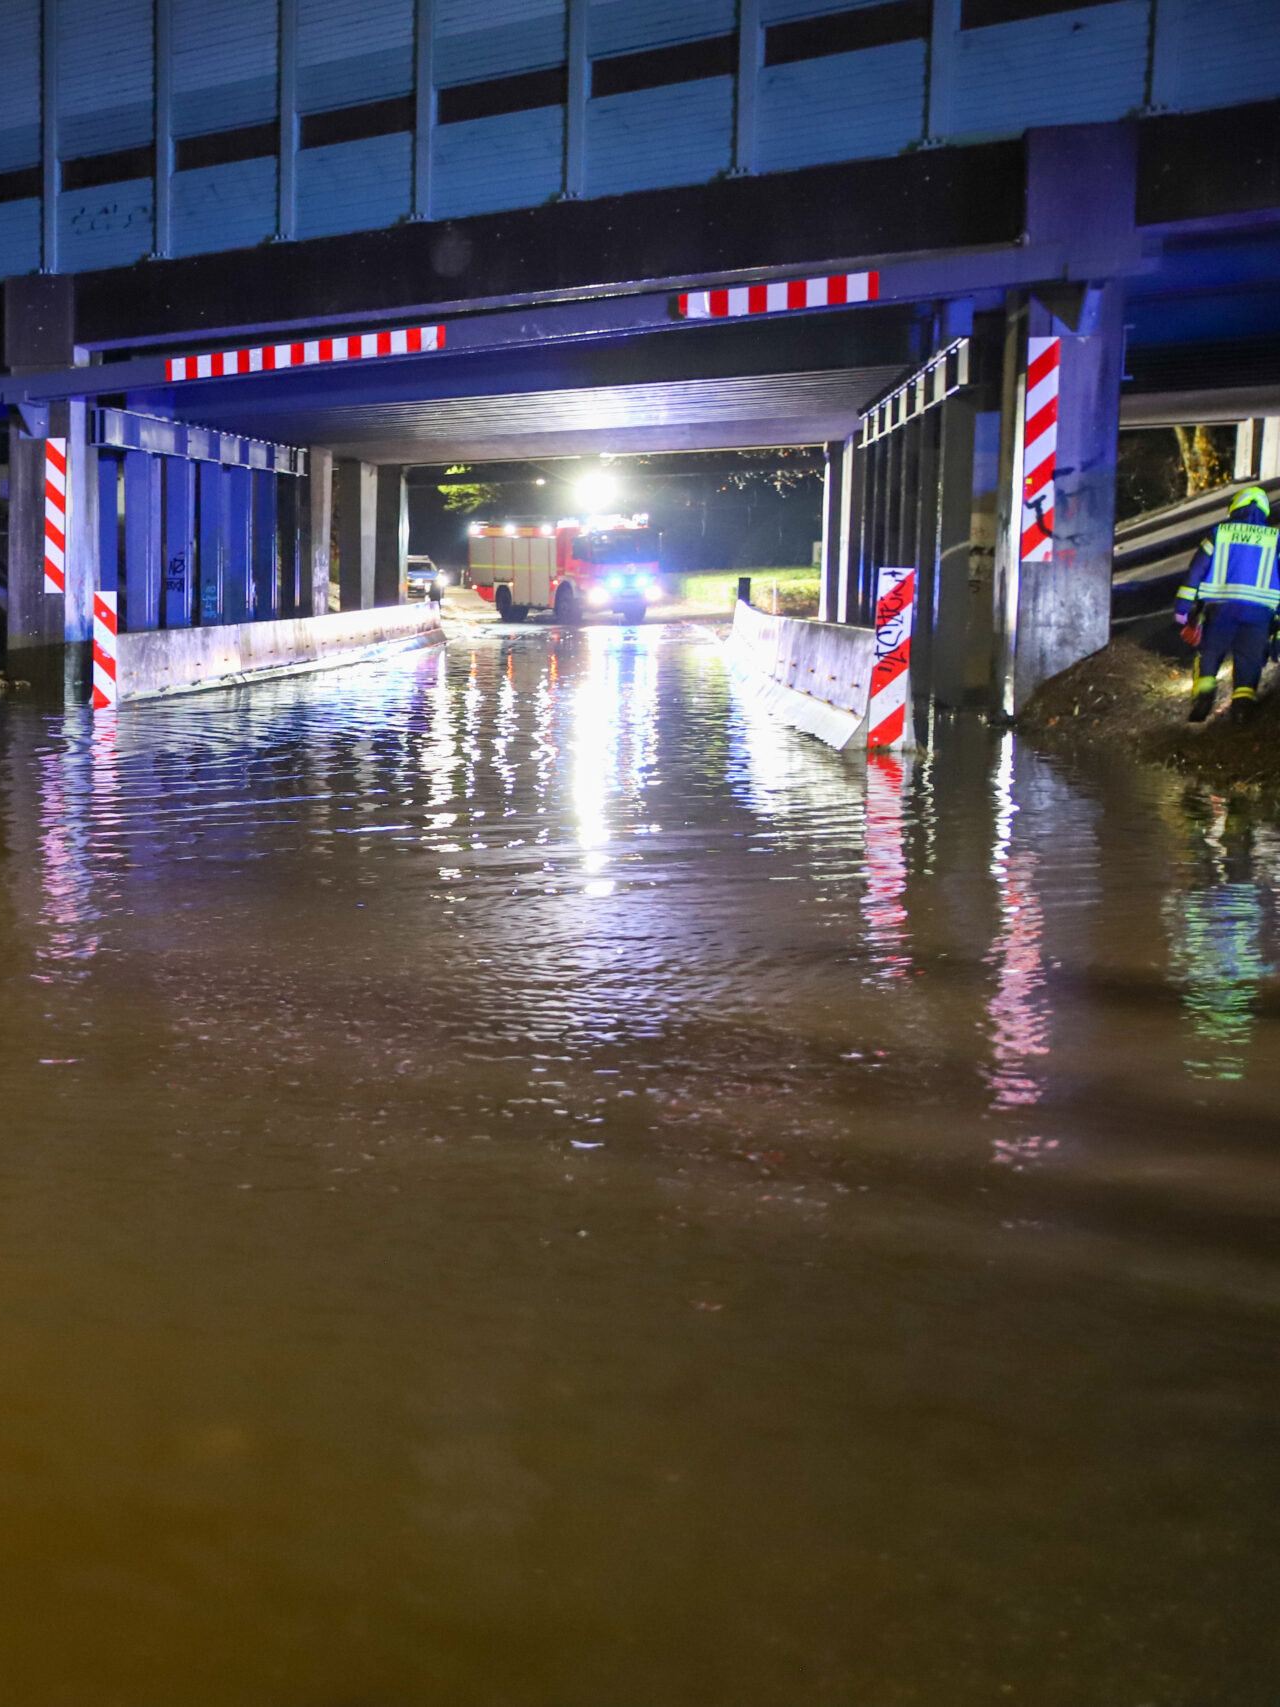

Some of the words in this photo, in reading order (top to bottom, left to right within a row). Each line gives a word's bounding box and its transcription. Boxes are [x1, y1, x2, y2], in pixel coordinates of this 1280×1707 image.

[1220, 523, 1278, 536] RELLINGEN
[1231, 533, 1251, 543] RW
[1254, 534, 1263, 545] 2
